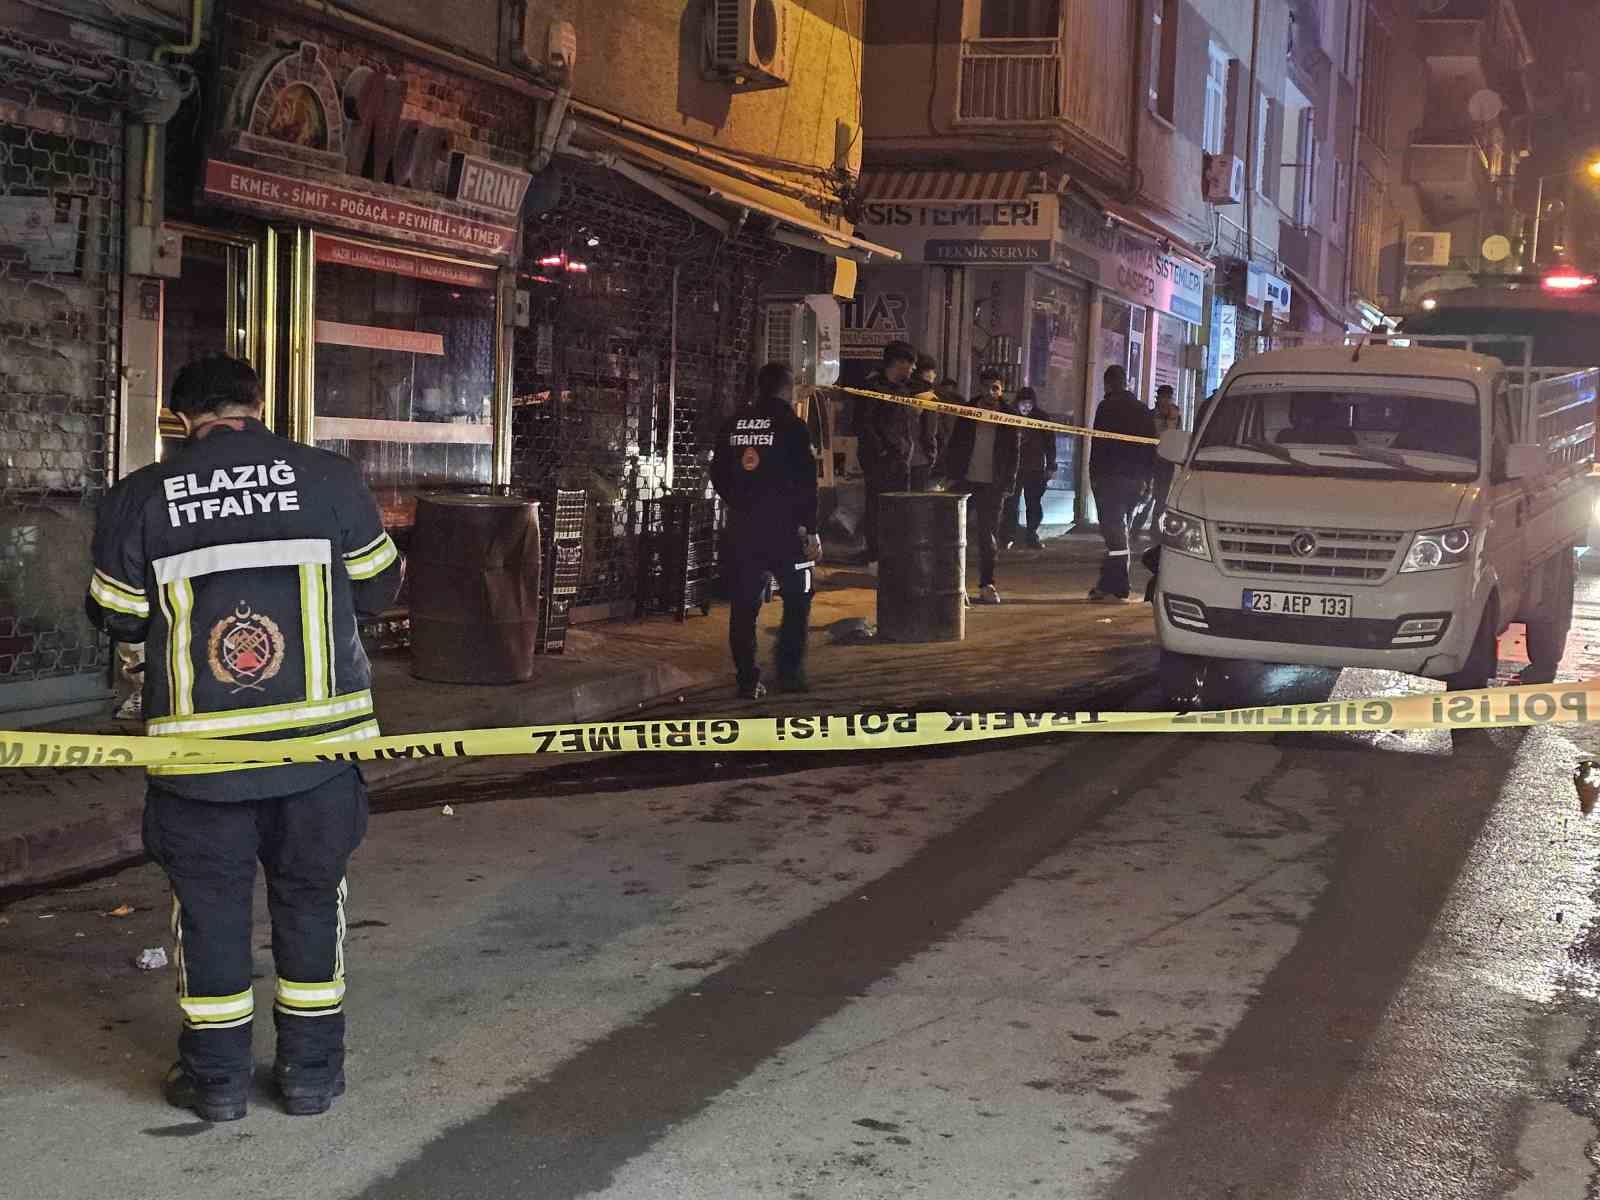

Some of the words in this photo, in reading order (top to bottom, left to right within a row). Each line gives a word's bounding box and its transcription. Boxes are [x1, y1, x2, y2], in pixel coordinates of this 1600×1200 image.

[463, 163, 521, 209] FIRINI
[230, 173, 281, 200] EKMEK
[291, 185, 329, 208] SİMİT
[339, 198, 389, 223] POĞAÇA
[398, 212, 450, 235] PEYNİRLİ
[458, 227, 501, 248] KATMER
[991, 245, 1040, 258] SERVİS
[163, 459, 297, 501] ELAZIĞ
[167, 489, 300, 528] İTFAİYE
[1253, 594, 1272, 611] 23
[1282, 596, 1312, 613] AEP
[1320, 598, 1347, 616] 133
[531, 719, 740, 753] GİRİLMEZ
